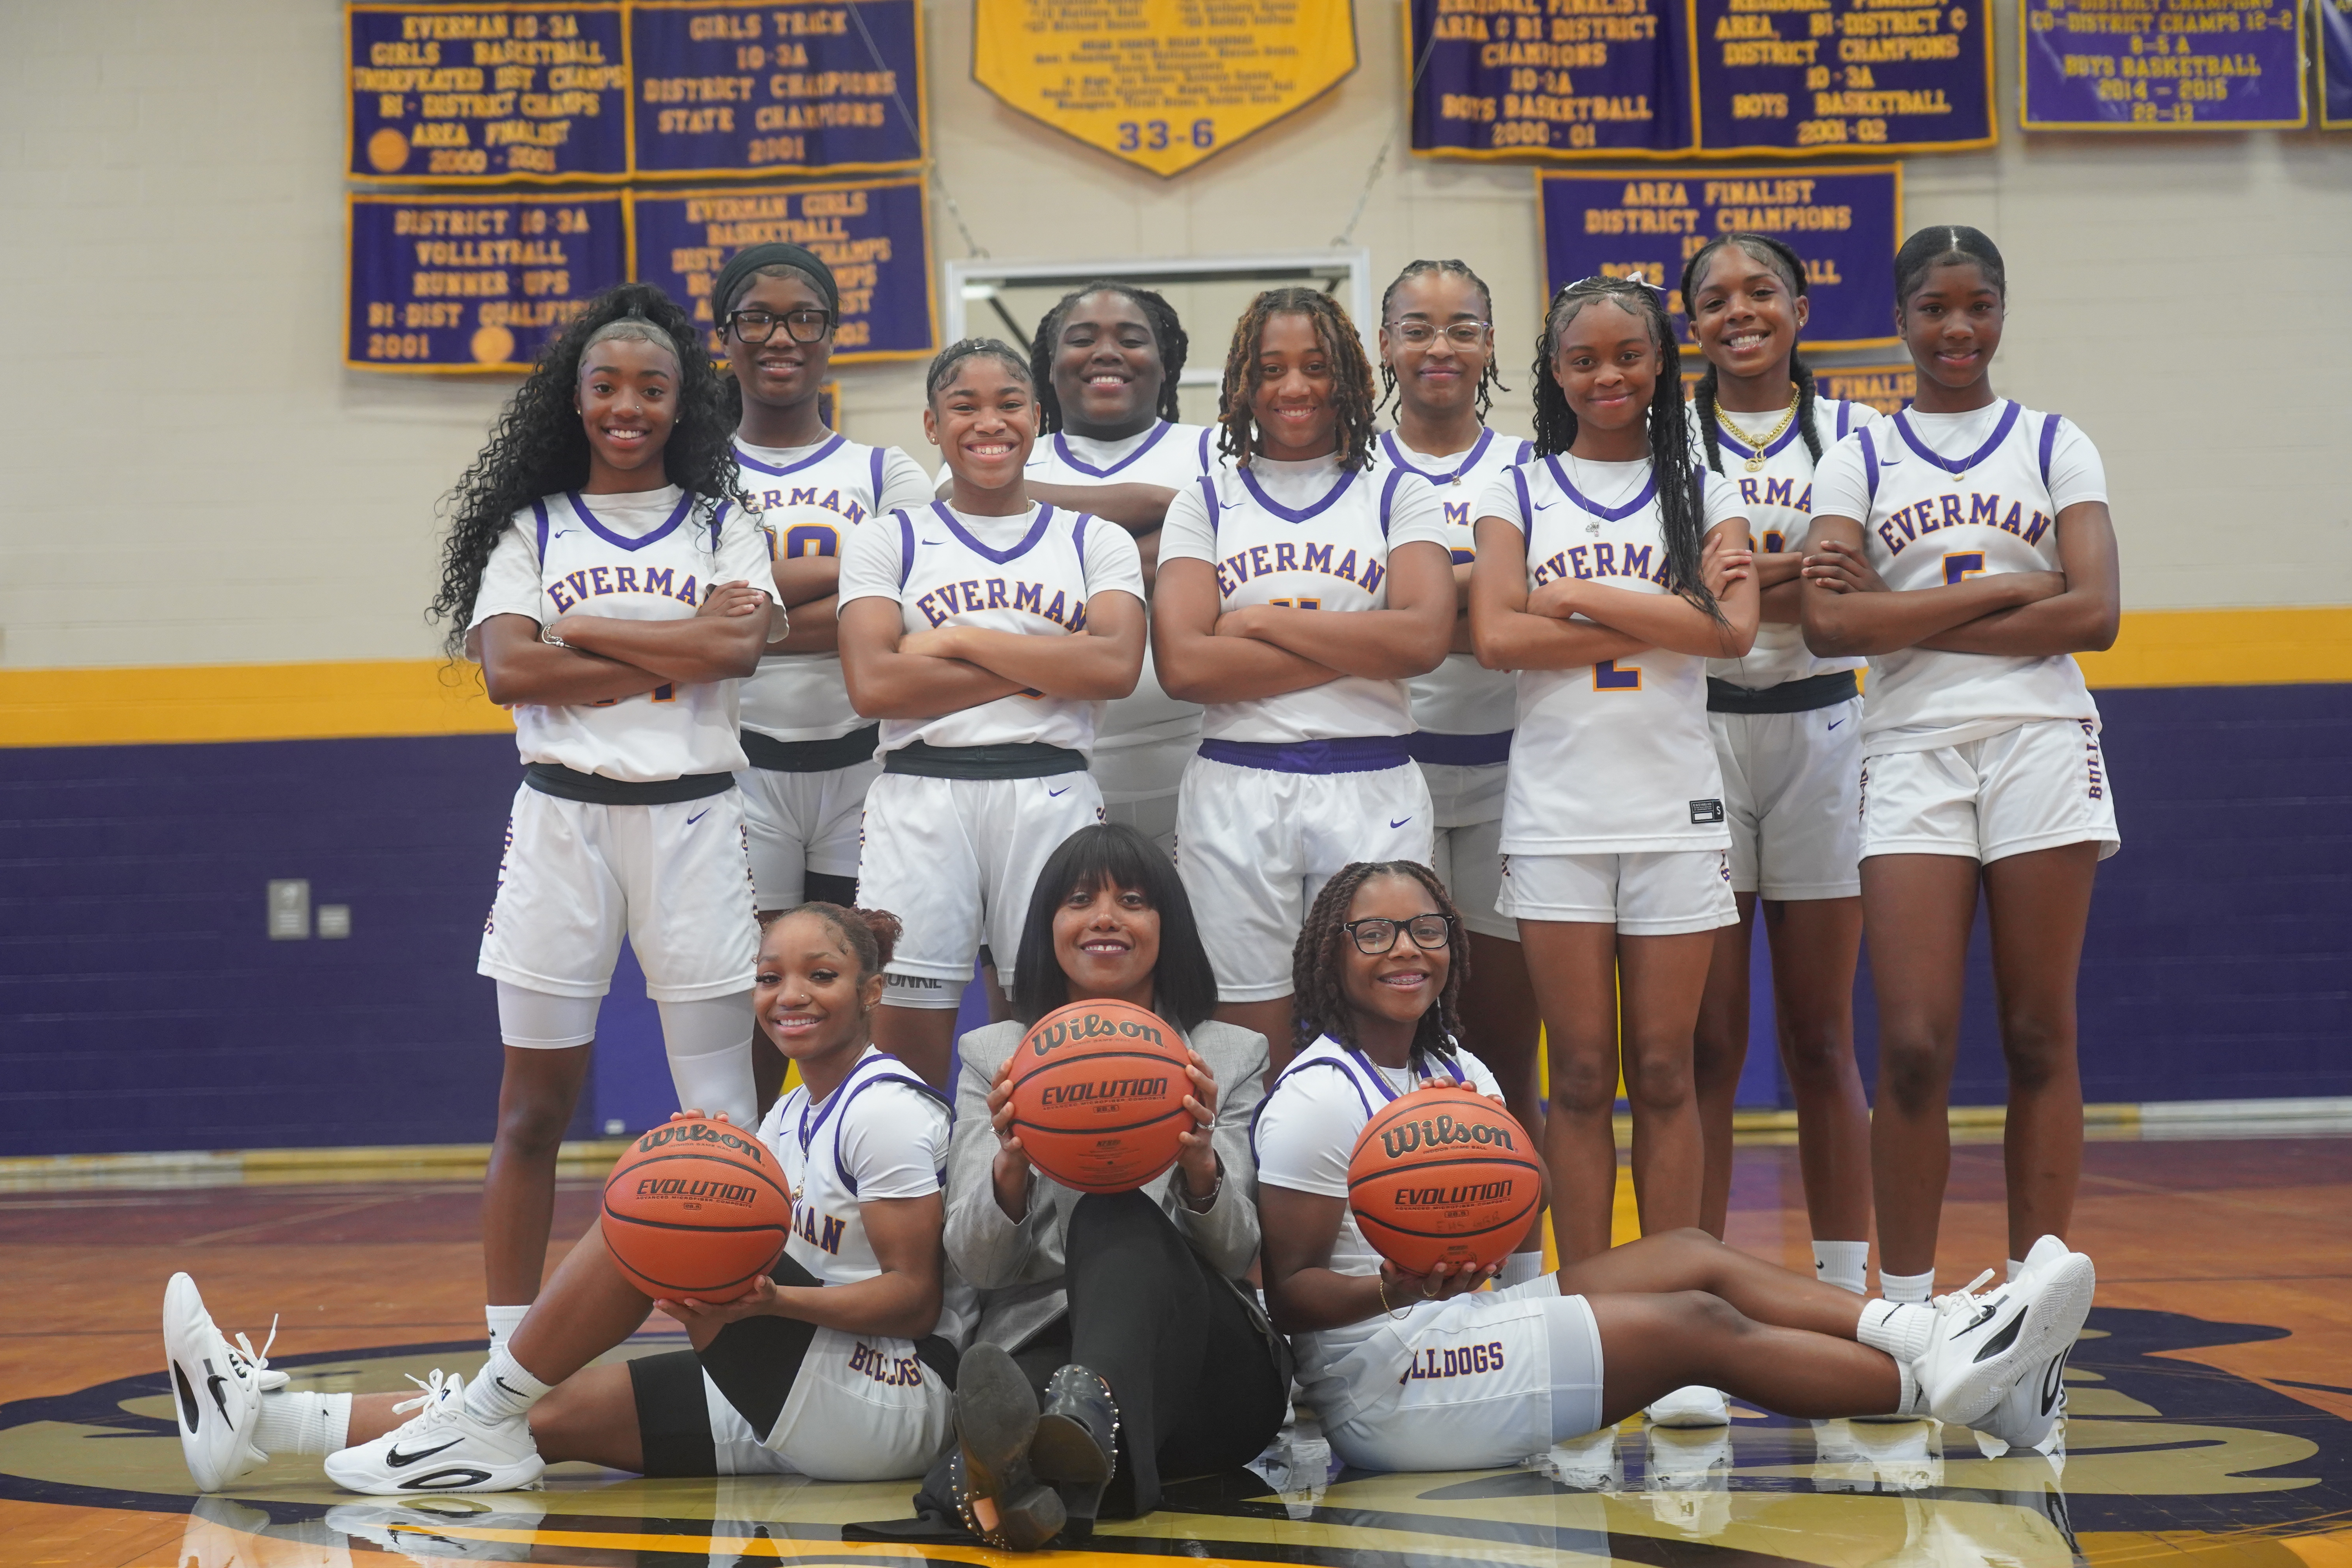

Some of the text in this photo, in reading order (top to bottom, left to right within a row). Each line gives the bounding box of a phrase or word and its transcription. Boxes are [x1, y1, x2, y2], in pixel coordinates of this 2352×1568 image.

[404, 15, 508, 39] EVERMAN
[691, 11, 845, 40] GIRLS TRACK
[1436, 16, 1488, 40] AREA
[2160, 13, 2239, 31] CHAMPS
[371, 40, 604, 65] GIRLS BASKETBALL
[1483, 42, 1606, 67] CHAMPIONS
[1724, 35, 1959, 66] DISTRICT CHAMPIONS
[2065, 56, 2260, 77] BOYS BASKETBALL
[644, 72, 895, 102] DISTRICT CHAMPIONS
[1443, 94, 1652, 120] BOYS BASKETBALL
[1733, 91, 1950, 117] BOYS BASKETBALL
[659, 103, 883, 132] STATE CHAMPIONS
[802, 192, 867, 216] GIRLS
[1624, 180, 1815, 207] AREA FINALIST
[396, 211, 508, 234] DISTRICT
[1586, 207, 1851, 233] DISTRICT CHAMPIONS
[416, 240, 566, 265] VOLLEYBALL
[368, 335, 428, 358] 2001
[1831, 374, 1916, 399] FINALIS
[746, 487, 867, 525] ERMAN
[1878, 493, 2051, 557] EVERMAN
[1216, 542, 1386, 600] EVERMAN
[547, 566, 706, 615] EVERMA
[916, 578, 1087, 633] EVERMAN
[1717, 806, 1721, 815] S
[1031, 1014, 1165, 1056] Wilson
[1042, 1078, 1167, 1105] EVOLUTION
[639, 1124, 762, 1164] Wilson
[1379, 1114, 1514, 1158] Wilson
[637, 1179, 757, 1203] EVOLUTION
[1395, 1180, 1512, 1205] EVOLUTION
[1477, 1198, 1511, 1207] COMPOSITE
[716, 1200, 752, 1209] COMPOSITE
[1399, 1341, 1504, 1385] LLDOGS
